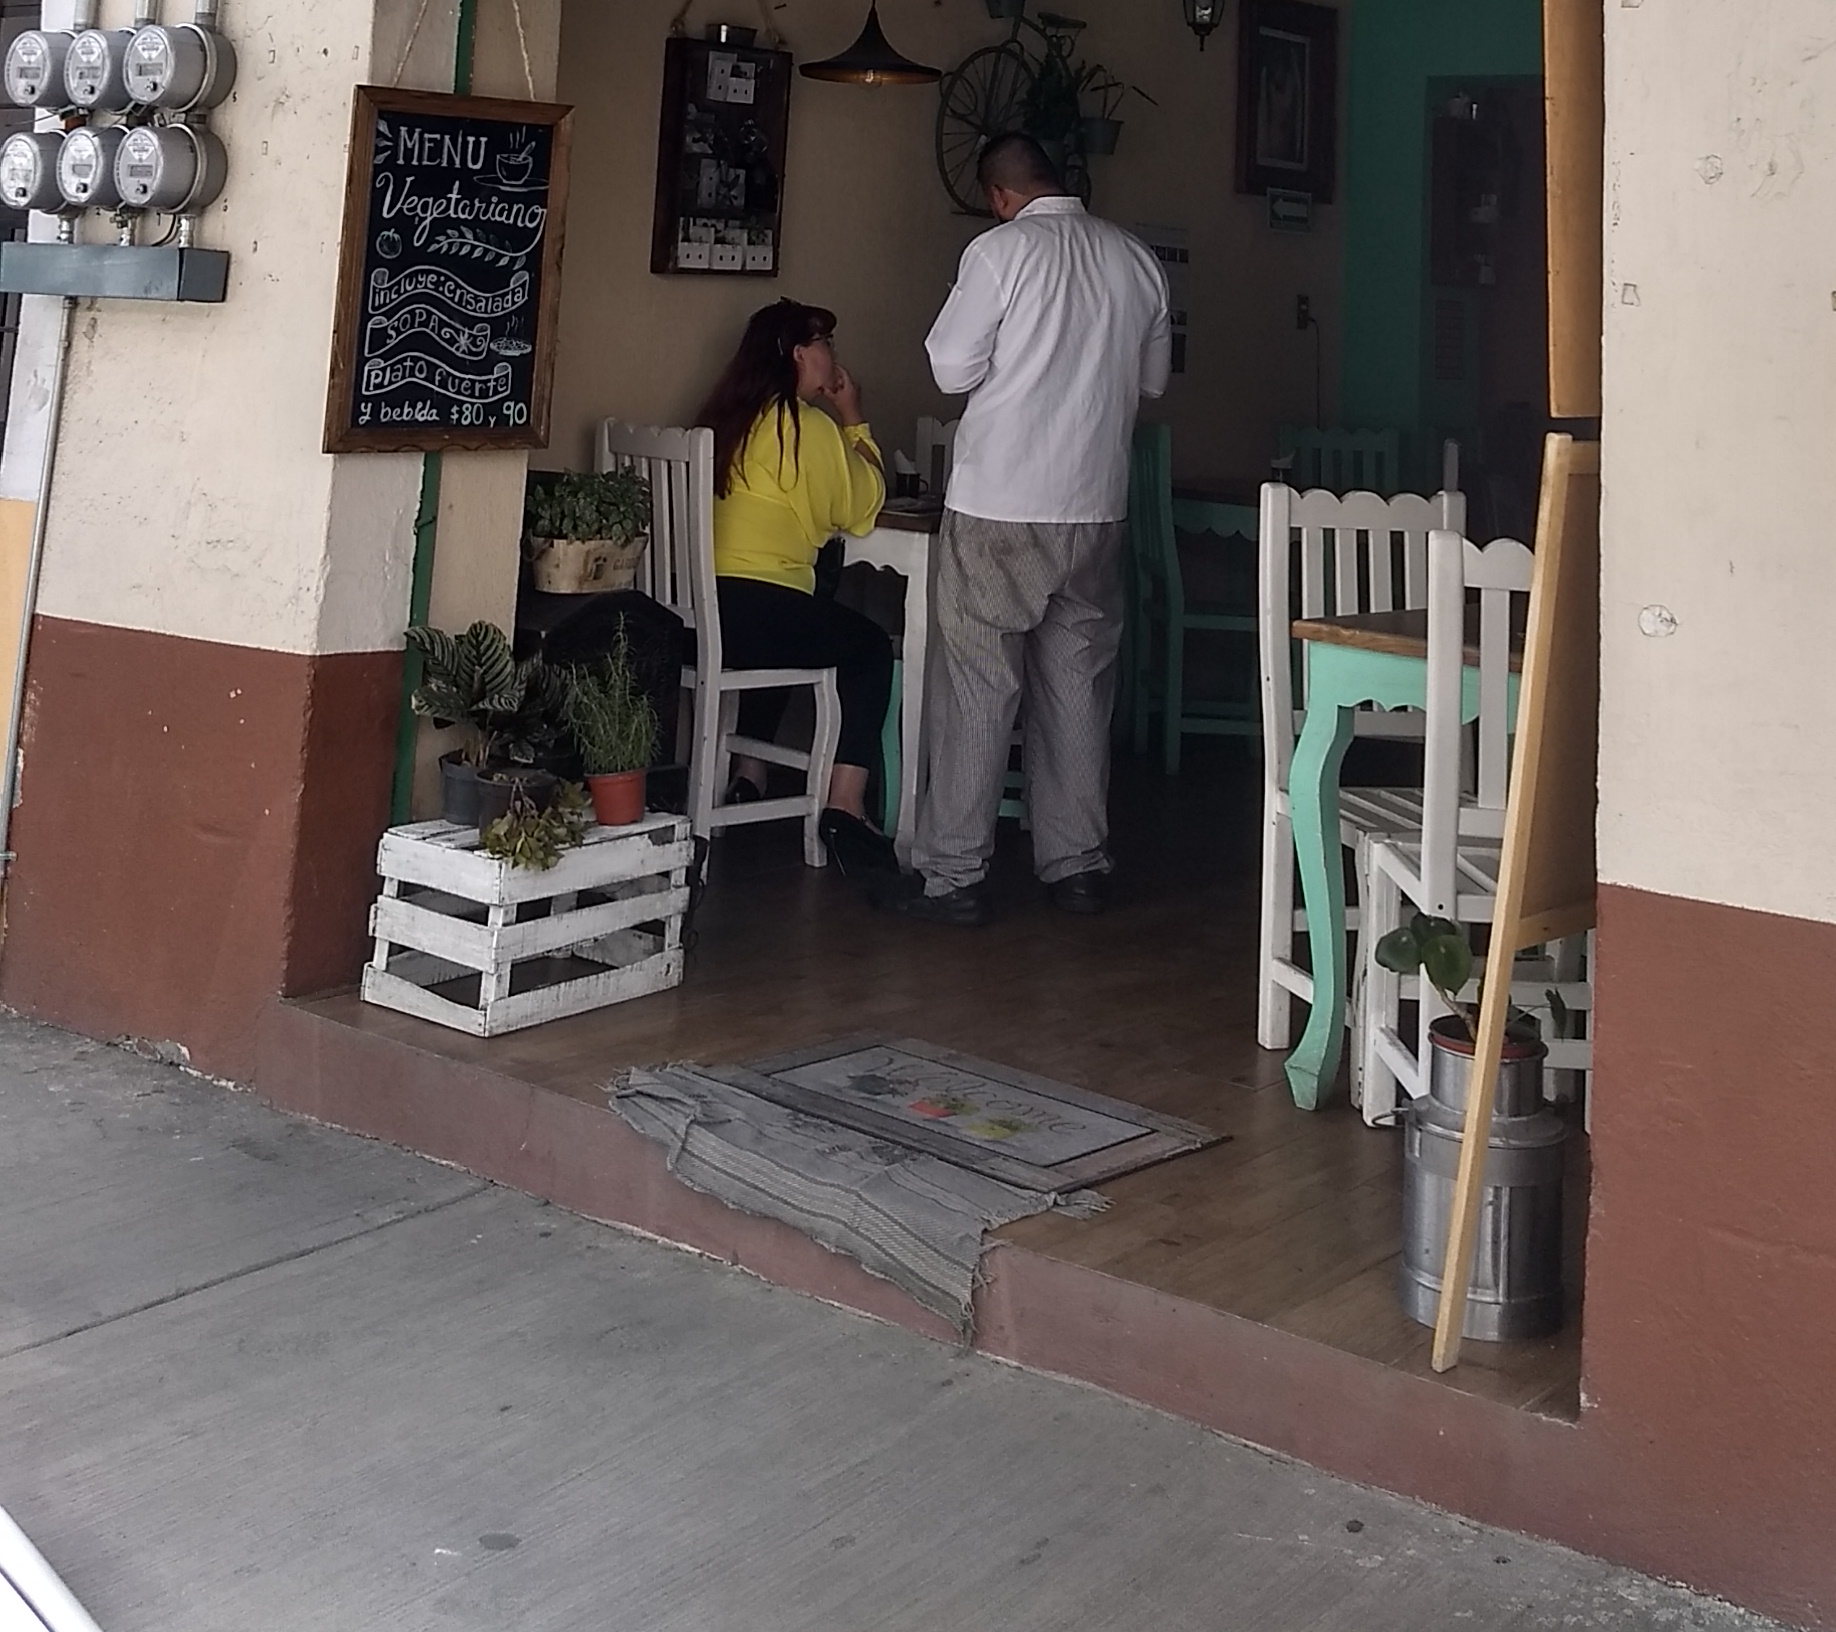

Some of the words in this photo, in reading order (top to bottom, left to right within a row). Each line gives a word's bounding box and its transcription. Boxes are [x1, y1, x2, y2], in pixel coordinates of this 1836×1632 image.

[395, 125, 488, 169] MENU
[375, 172, 547, 248] Vegetariano
[386, 309, 439, 344] SOPA
[435, 368, 507, 397] fuerte
[380, 399, 440, 422] bebida
[450, 403, 484, 426] $80
[502, 401, 527, 427] 90
